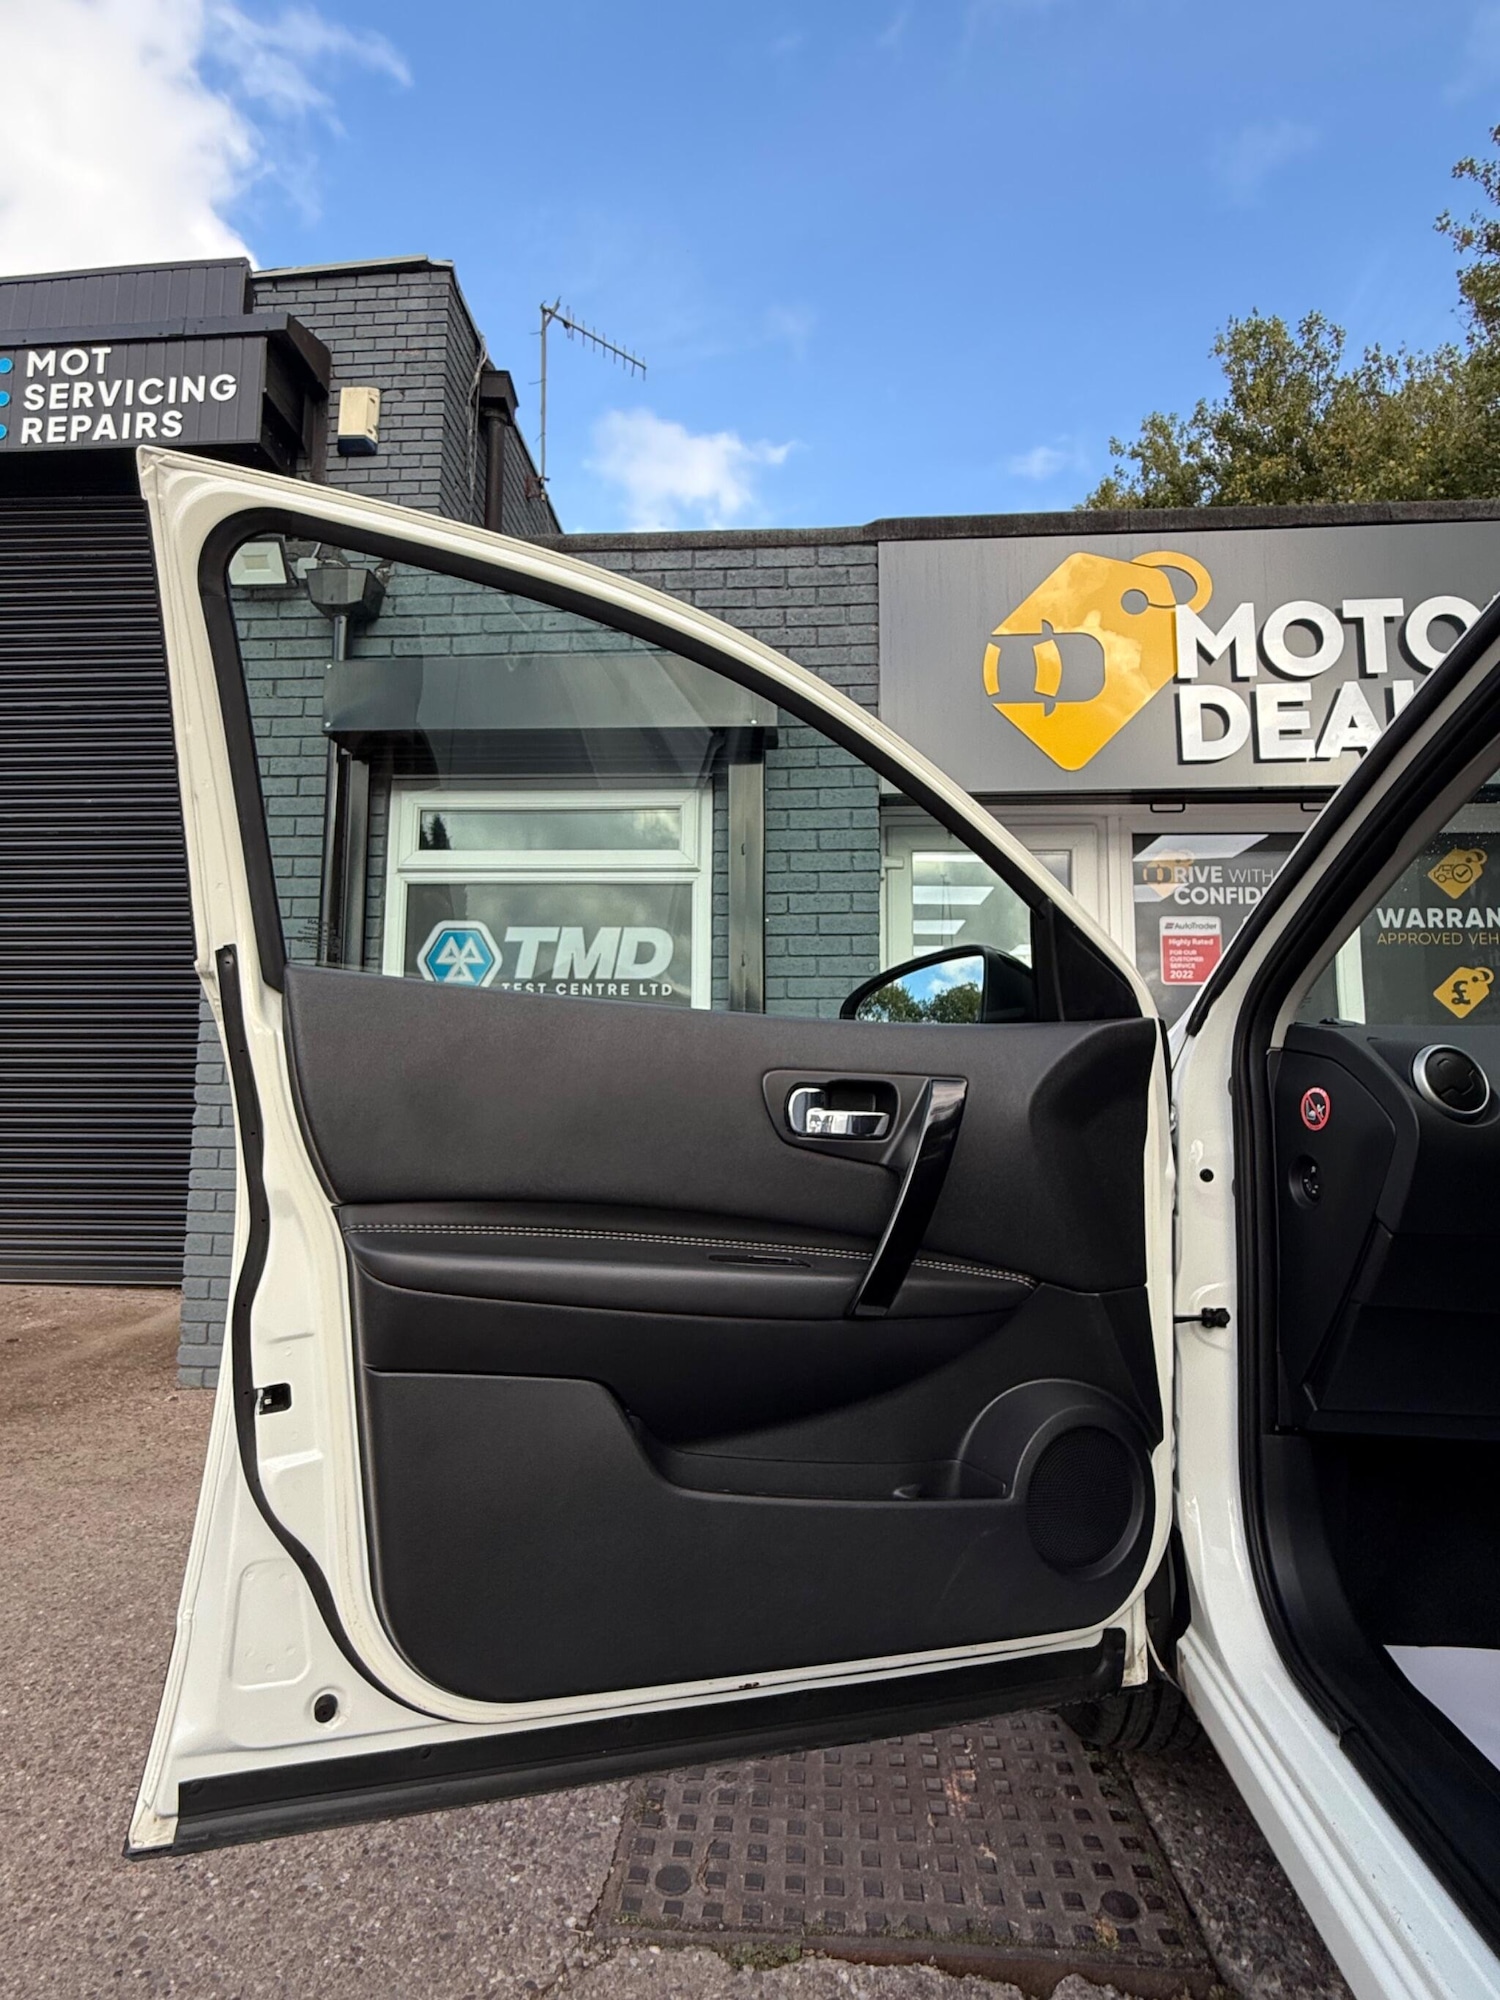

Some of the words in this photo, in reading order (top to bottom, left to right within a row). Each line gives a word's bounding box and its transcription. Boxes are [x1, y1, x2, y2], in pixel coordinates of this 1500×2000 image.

[26, 347, 111, 377] MOT
[23, 374, 237, 411] SERVICING
[20, 410, 183, 444] REPAIRS
[1176, 596, 1484, 679] MOTO
[1228, 868, 1274, 884] WITH
[1173, 886, 1269, 906] CONFID
[1376, 906, 1500, 929] WARRAN
[1168, 938, 1191, 947] Highly
[1191, 938, 1214, 946] Rated
[1377, 932, 1463, 946] APPROVED
[1468, 932, 1500, 945] VEH
[504, 926, 674, 980] TMD
[1170, 970, 1194, 979] 2022
[555, 983, 630, 996] CENTRE
[639, 983, 673, 996] LTD
